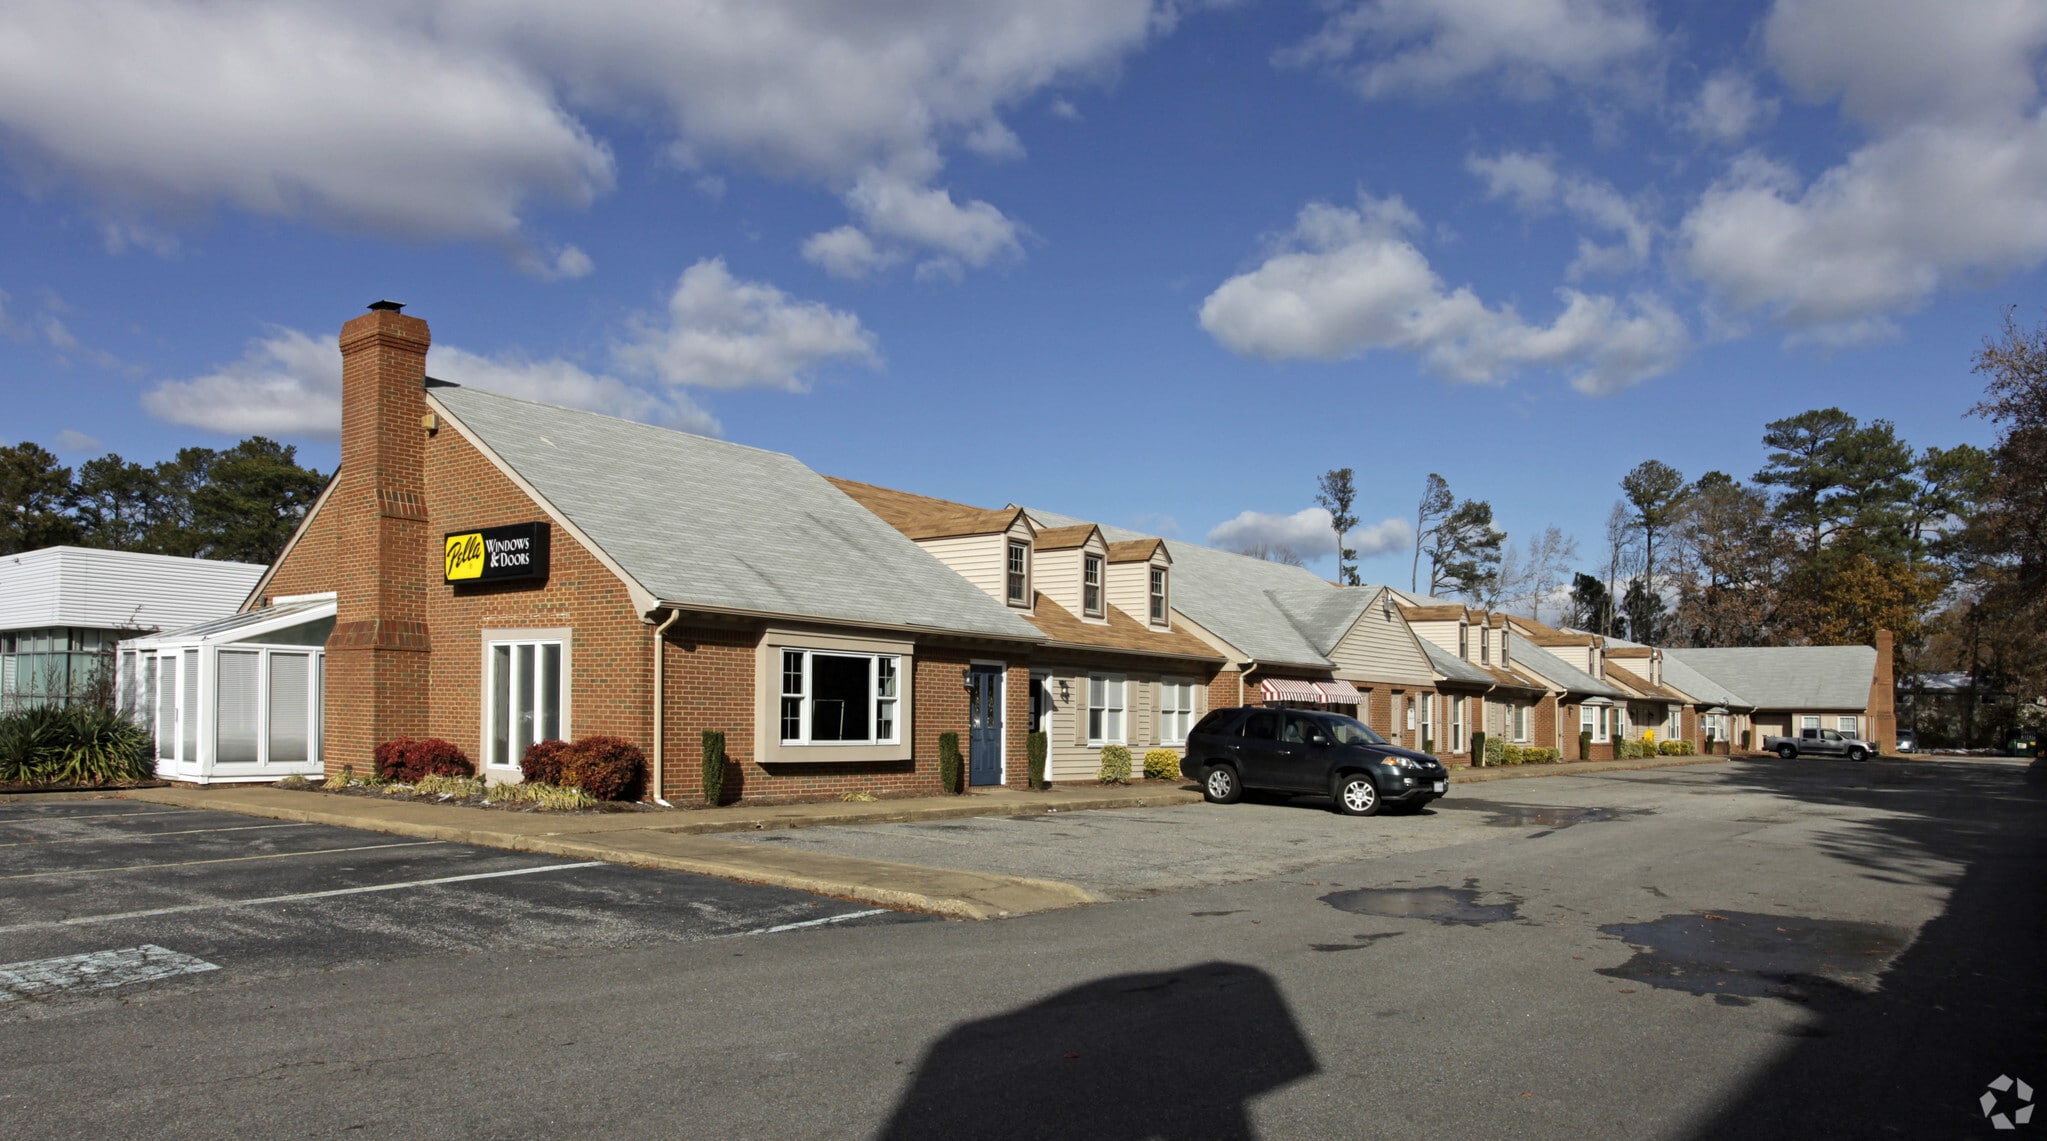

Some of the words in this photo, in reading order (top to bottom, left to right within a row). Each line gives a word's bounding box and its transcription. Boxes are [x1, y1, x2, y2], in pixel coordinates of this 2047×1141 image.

[486, 537, 530, 553] WINDOWS
[490, 552, 500, 568] &
[500, 552, 530, 567] DOORS
